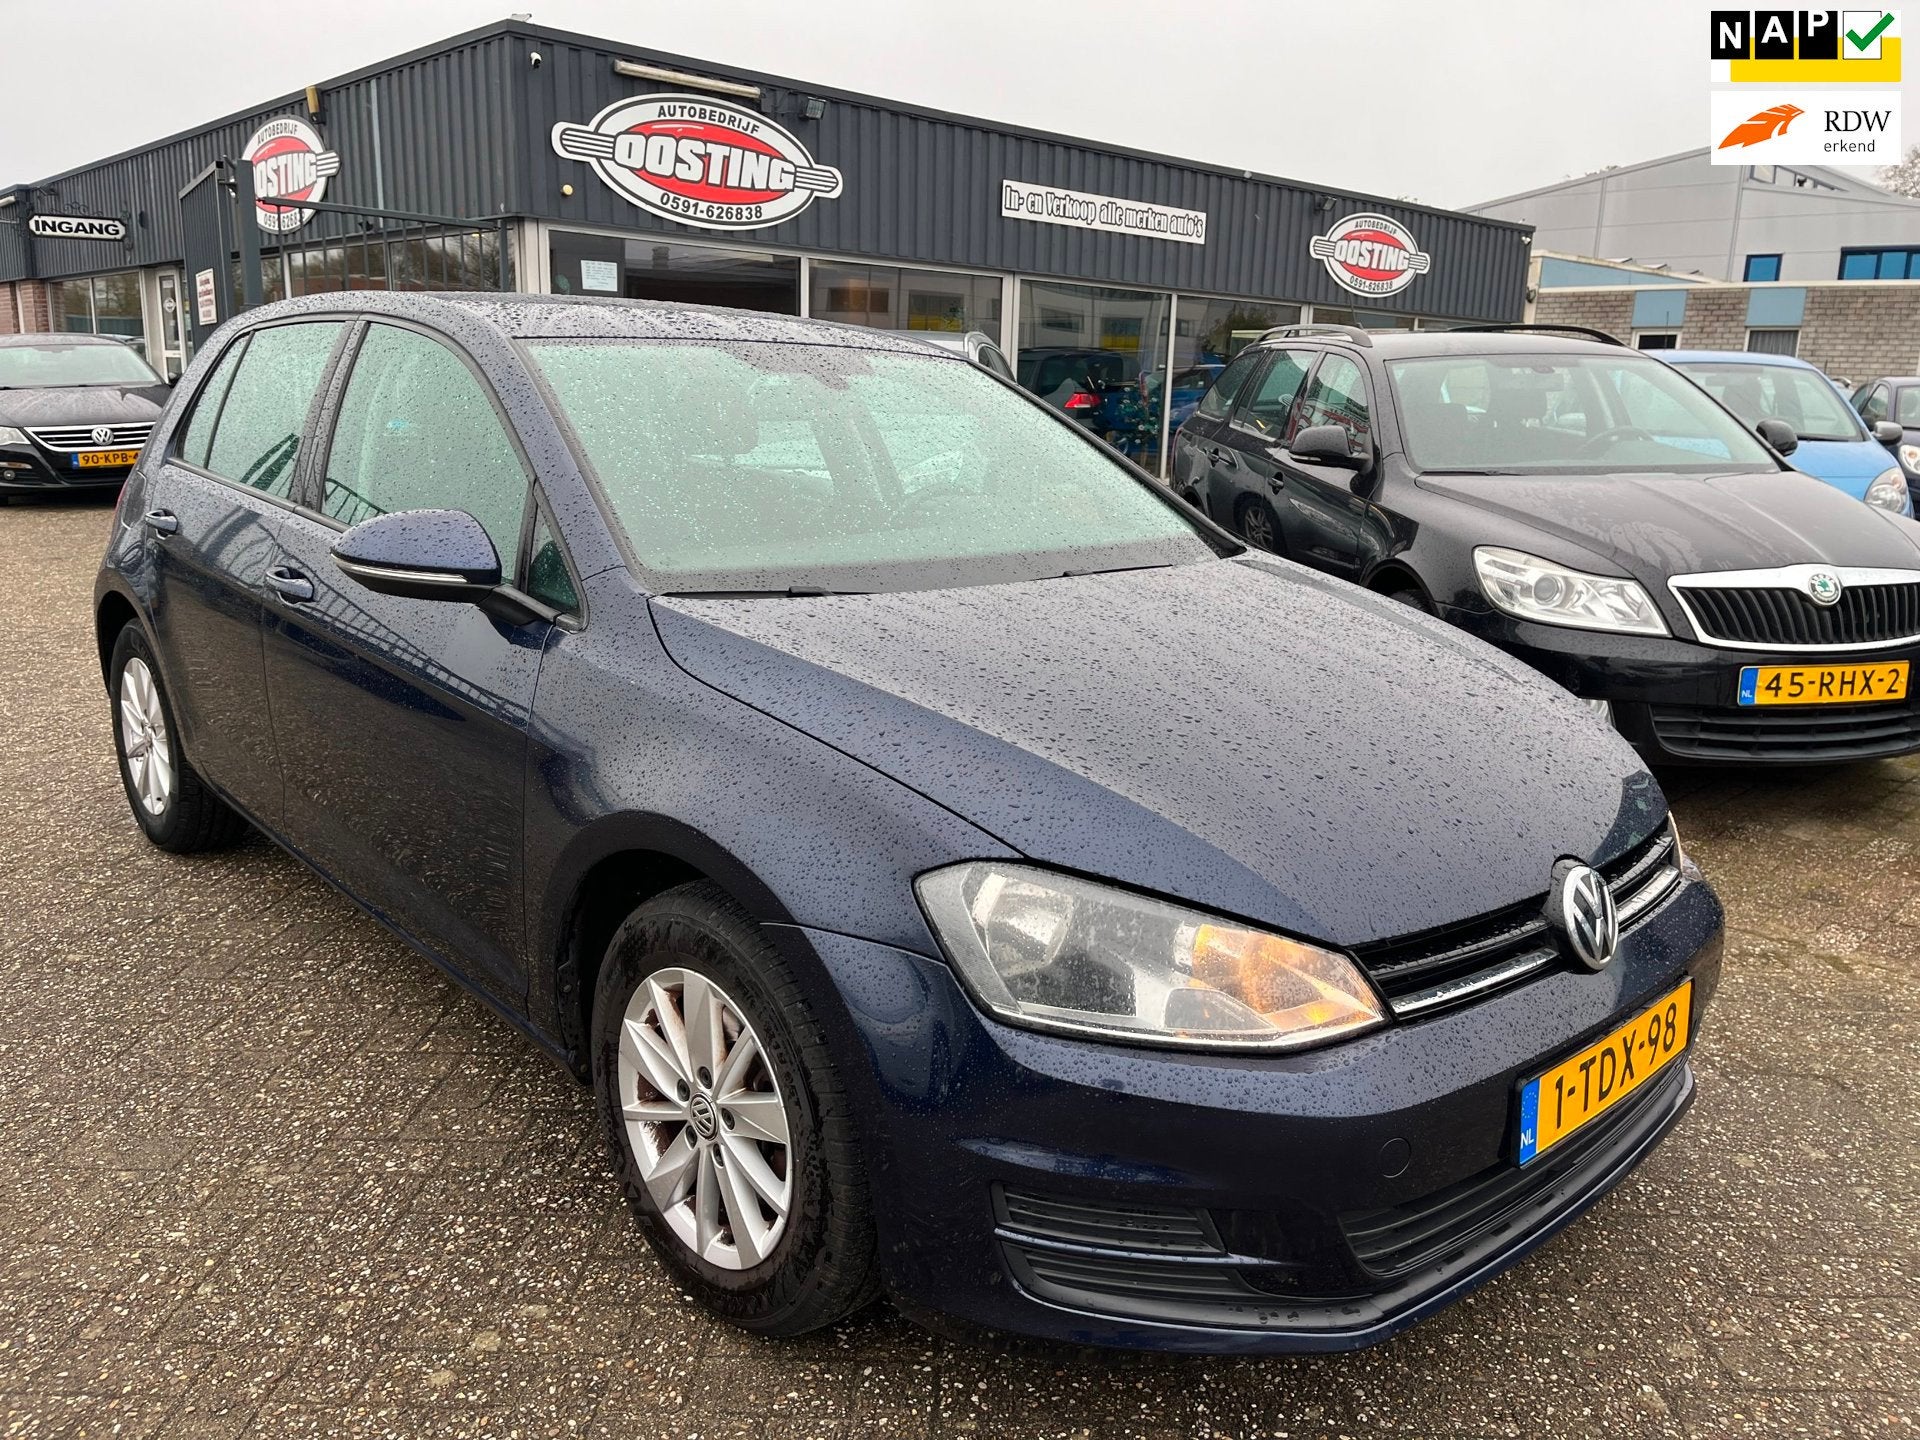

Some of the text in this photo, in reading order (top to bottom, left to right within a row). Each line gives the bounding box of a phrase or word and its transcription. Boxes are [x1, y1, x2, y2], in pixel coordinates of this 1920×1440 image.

[657, 104, 761, 135] AUTOBEDRIJF
[257, 122, 299, 147] AUTOBEDRIJF
[253, 152, 317, 198] OSTING
[613, 132, 797, 193] OOSTING
[659, 192, 763, 221] 0591-626838
[1005, 185, 1204, 238] In- en Verkoop alle merken auto's
[34, 219, 120, 236] INGANG
[1354, 219, 1398, 236] AUTOBEDRIJF
[1333, 239, 1411, 272] OOSTING
[1349, 275, 1394, 292] 0591-626838
[1741, 689, 1753, 699] NL
[1764, 668, 1901, 698] 45-RHX-2
[1554, 1001, 1678, 1131] 1-TDX-98
[1519, 1130, 1535, 1150] NL
